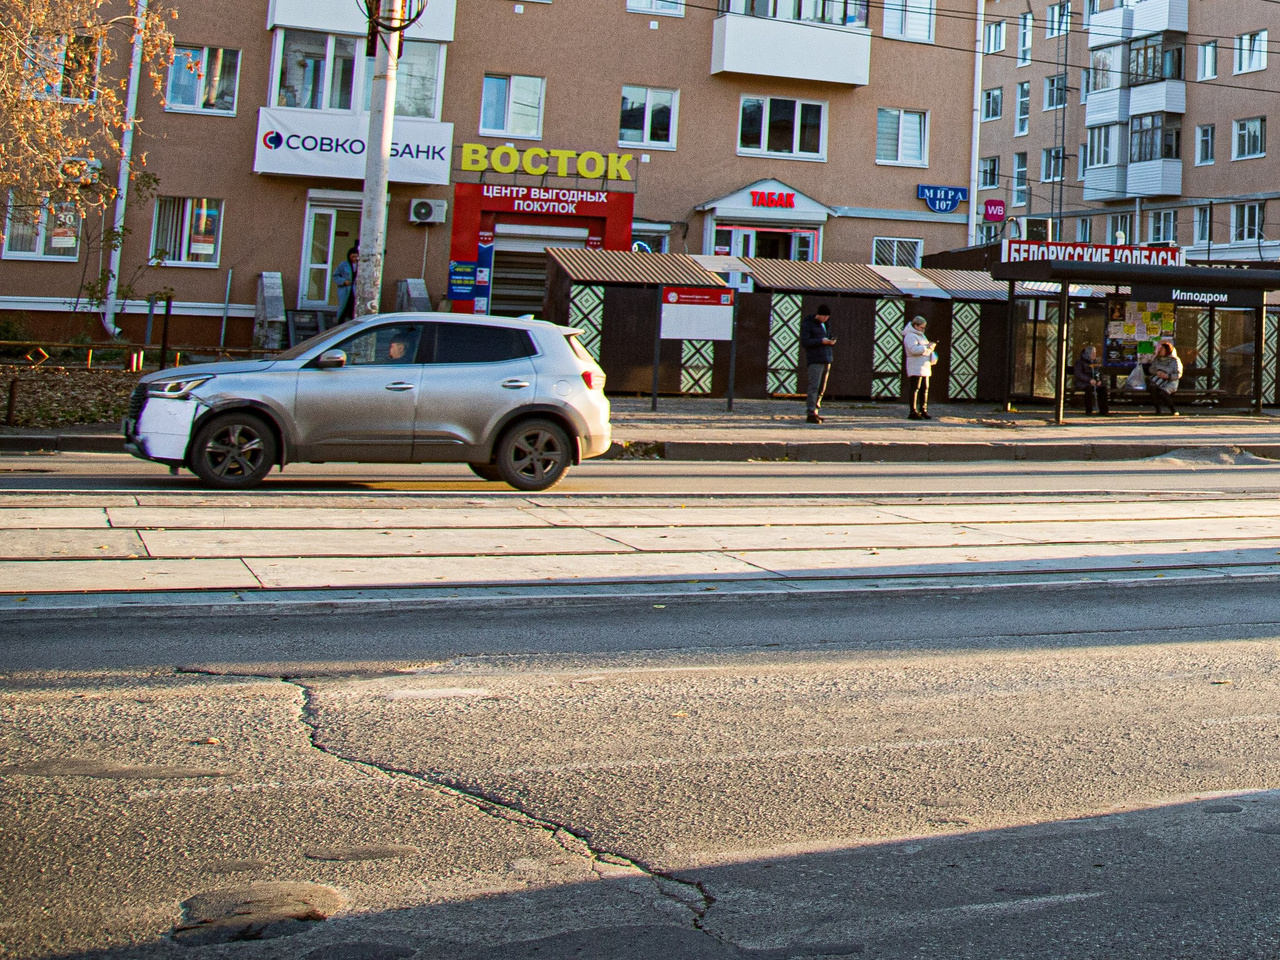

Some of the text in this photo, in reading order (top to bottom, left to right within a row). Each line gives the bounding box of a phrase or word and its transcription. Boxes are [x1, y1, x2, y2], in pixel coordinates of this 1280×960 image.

[286, 134, 447, 161] СОВКОБАНК
[461, 143, 633, 181] ВОСТОК
[483, 184, 608, 203] ЦЕНТР ВЫГОДНЫХ
[750, 190, 795, 208] ТАБАК
[923, 188, 963, 200] МИРА
[514, 200, 577, 214] ПОКУПОК
[935, 200, 952, 210] 107
[987, 205, 1004, 215] WB
[1172, 289, 1228, 303] Ипподром
